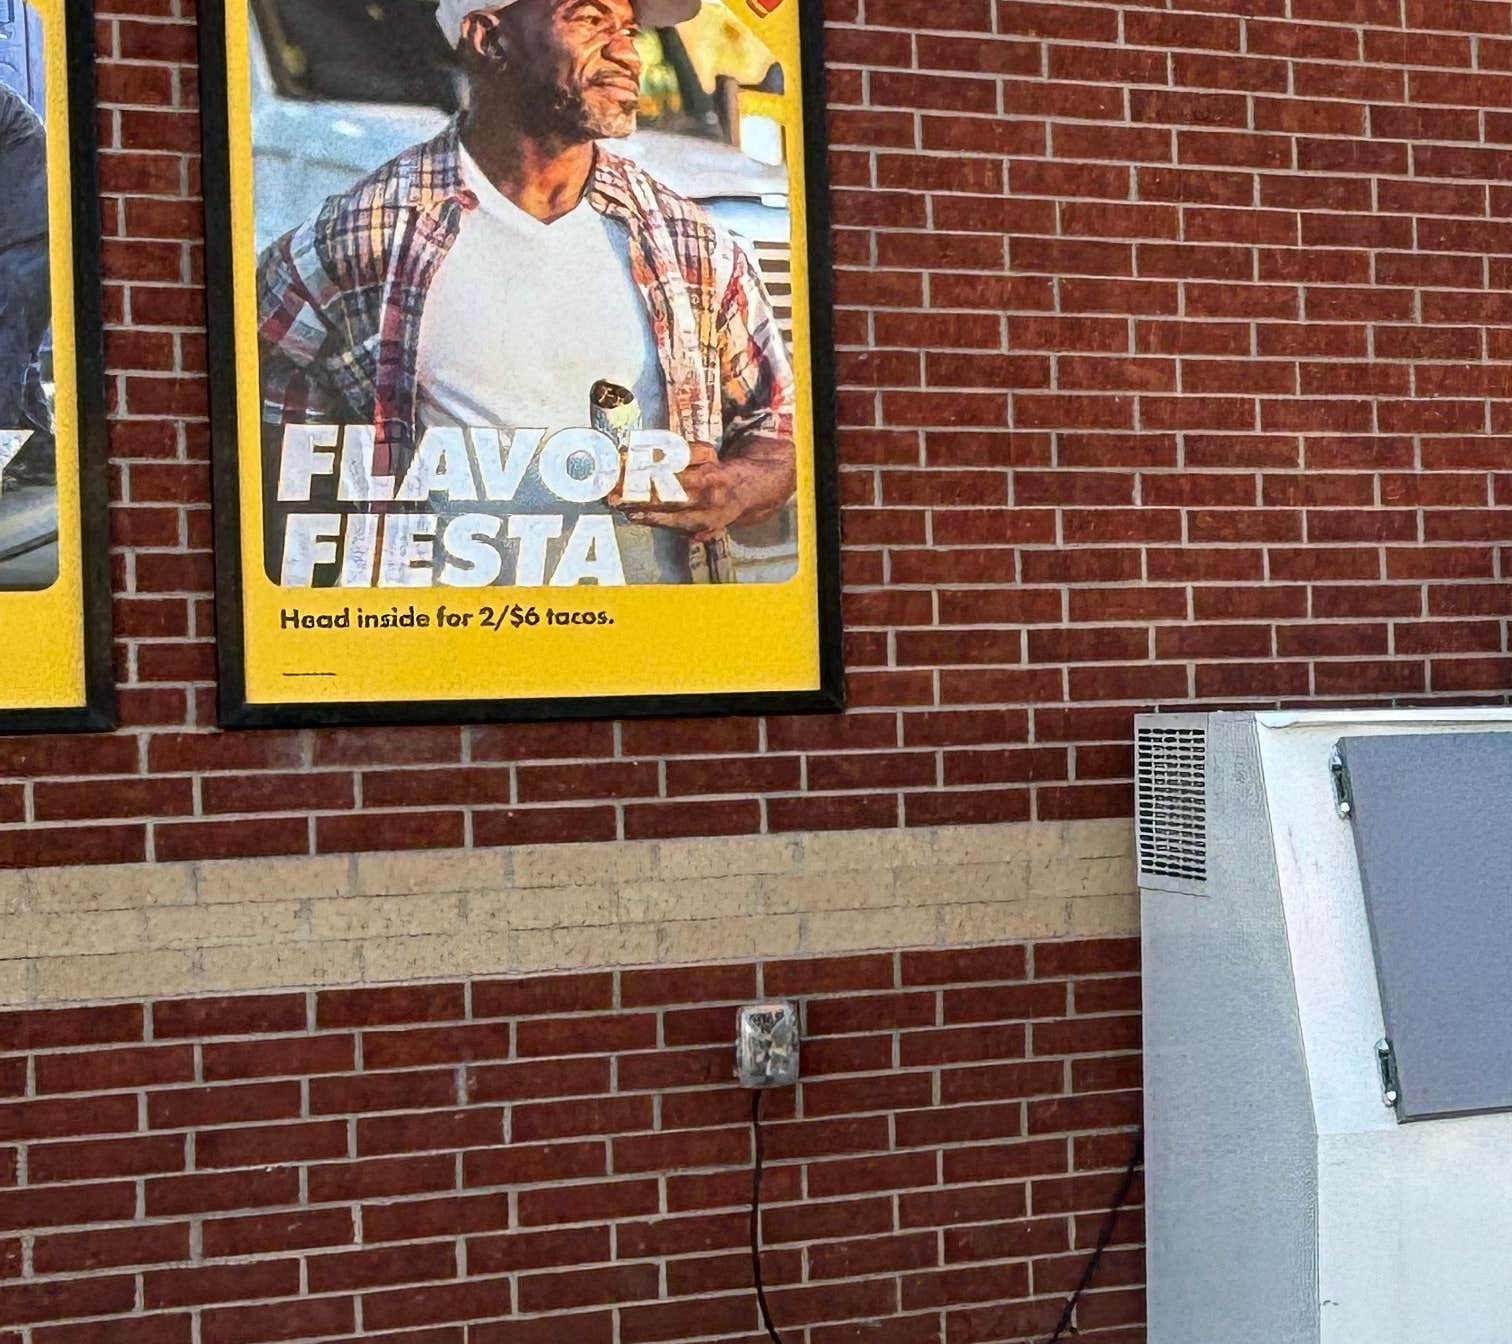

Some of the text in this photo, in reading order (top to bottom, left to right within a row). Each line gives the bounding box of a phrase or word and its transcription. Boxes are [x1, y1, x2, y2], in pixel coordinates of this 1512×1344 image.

[277, 423, 691, 504] FLAVOR
[280, 513, 627, 588] FIESTA
[280, 604, 615, 632] Head inside for 2/$6 tacos.
